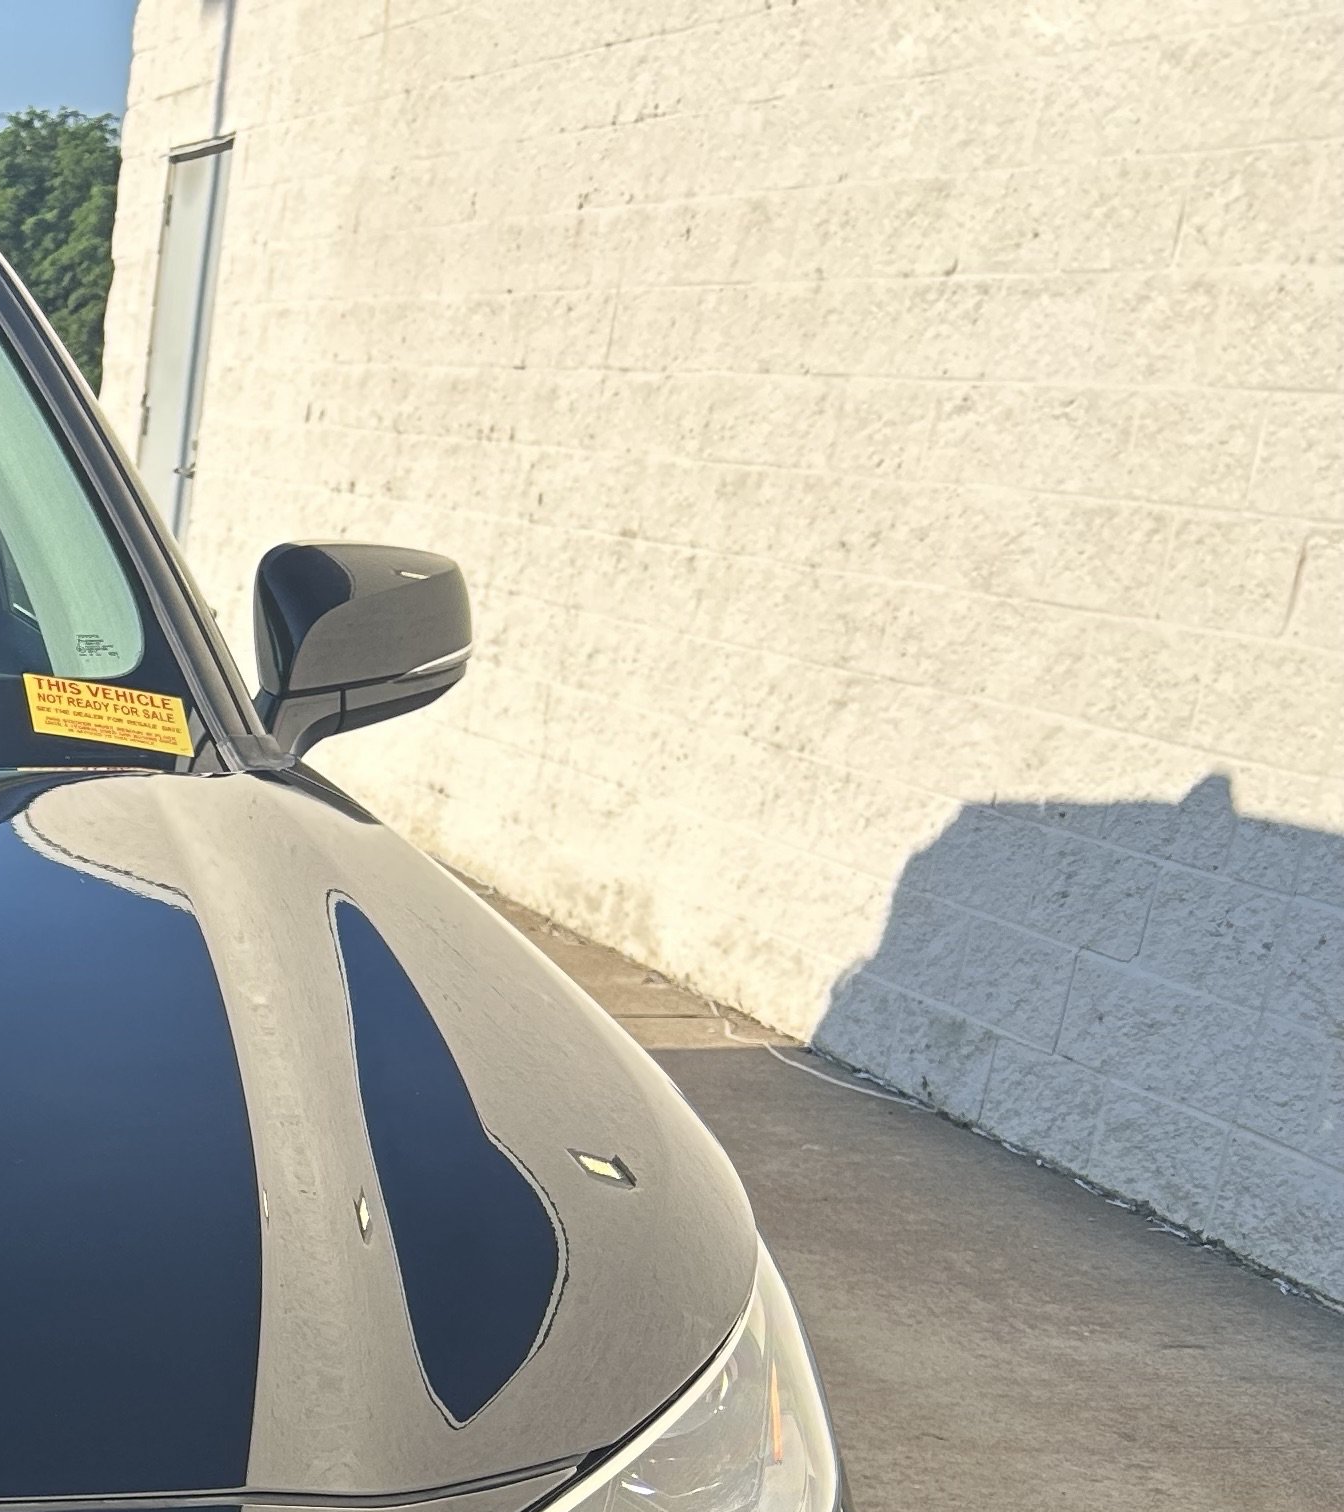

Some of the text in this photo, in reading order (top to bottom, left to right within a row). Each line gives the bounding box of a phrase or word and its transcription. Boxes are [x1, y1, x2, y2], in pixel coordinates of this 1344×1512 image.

[33, 677, 174, 710] THIS VEHICLE
[37, 692, 176, 723] NOT READY FOR SALE
